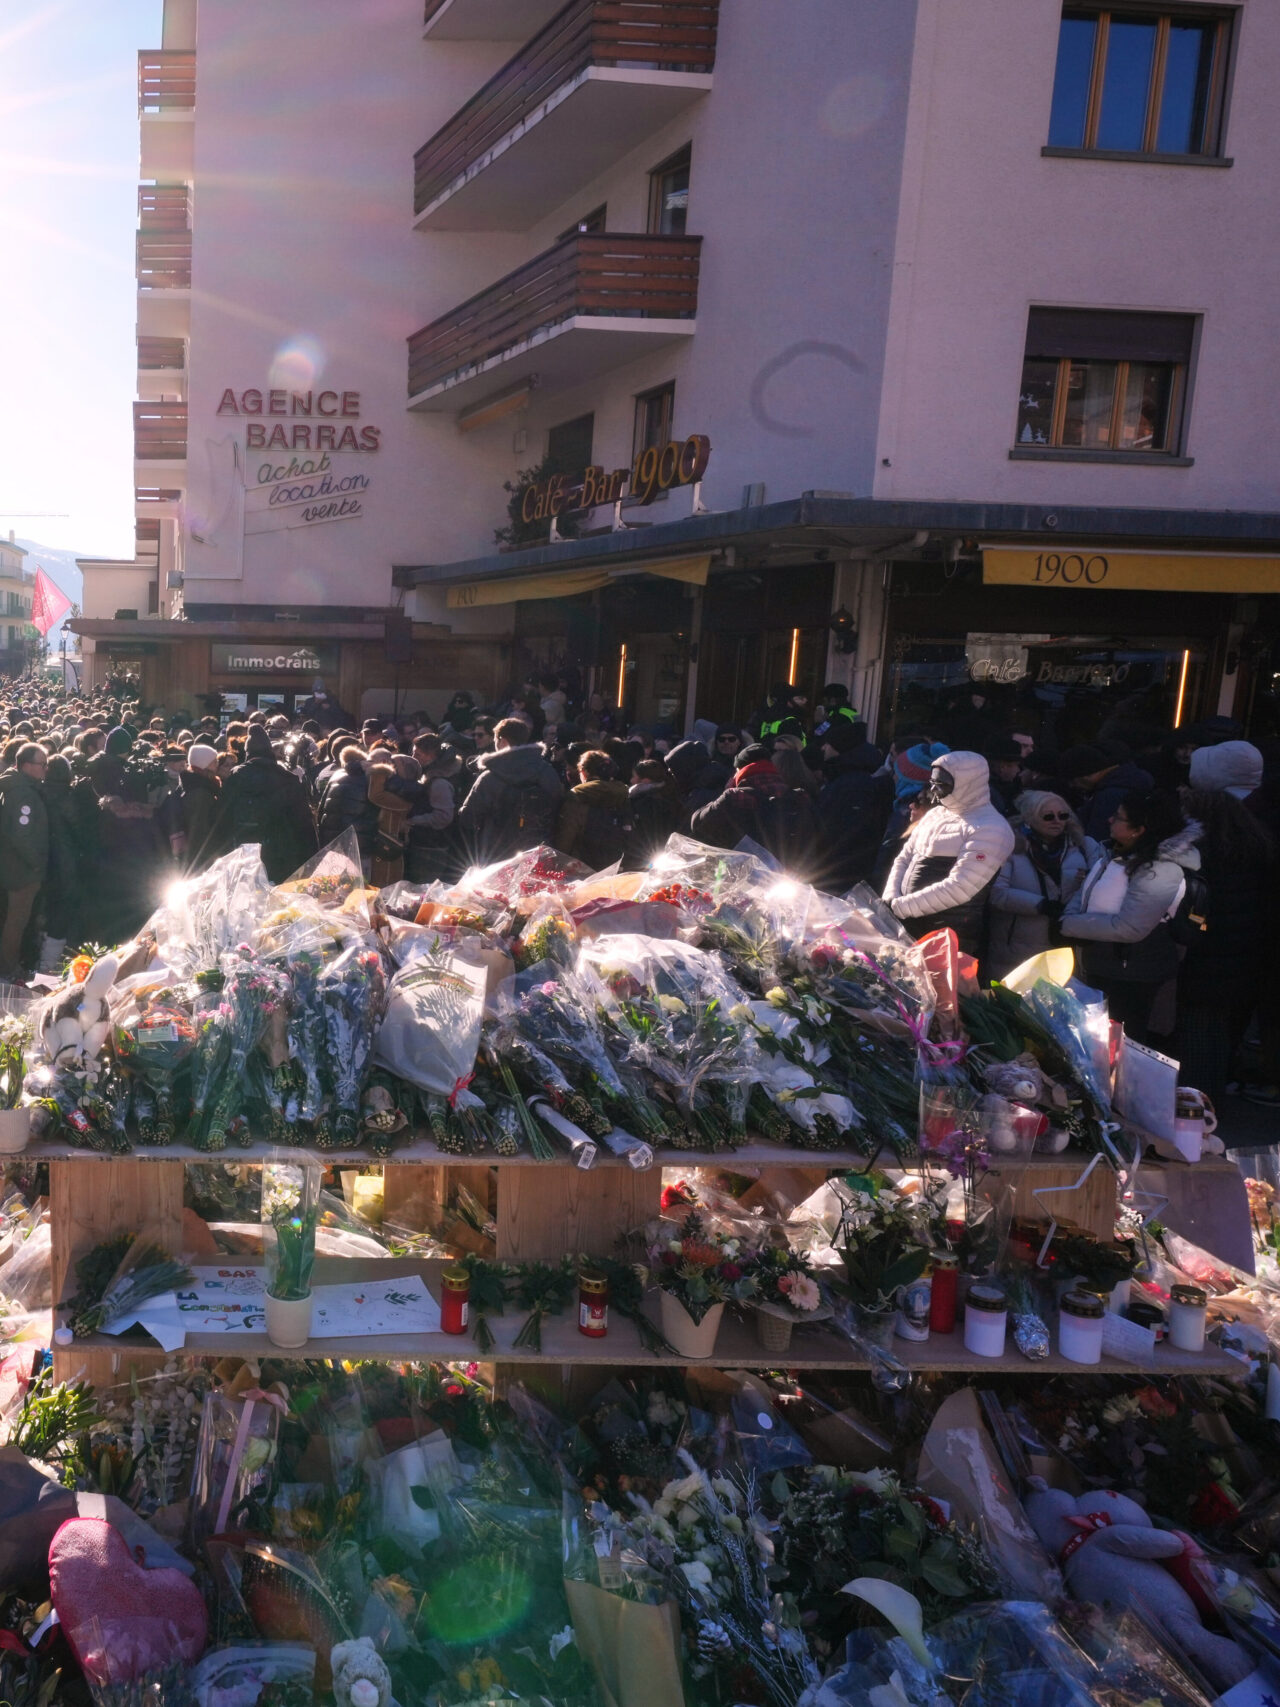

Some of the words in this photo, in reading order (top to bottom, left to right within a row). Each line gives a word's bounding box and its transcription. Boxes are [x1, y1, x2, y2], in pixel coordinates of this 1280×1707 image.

[217, 389, 361, 416] AGENCE
[246, 424, 381, 451] BARRAS
[270, 473, 370, 505] location
[521, 474, 563, 523] Café
[579, 466, 624, 508] Bar
[630, 434, 707, 505] 1900
[302, 499, 362, 522] vente
[1031, 554, 1109, 584] 1900
[228, 656, 320, 669] ImmoCrans
[971, 658, 1022, 684] Café
[217, 1269, 257, 1278] BAR
[177, 1292, 199, 1300] LA
